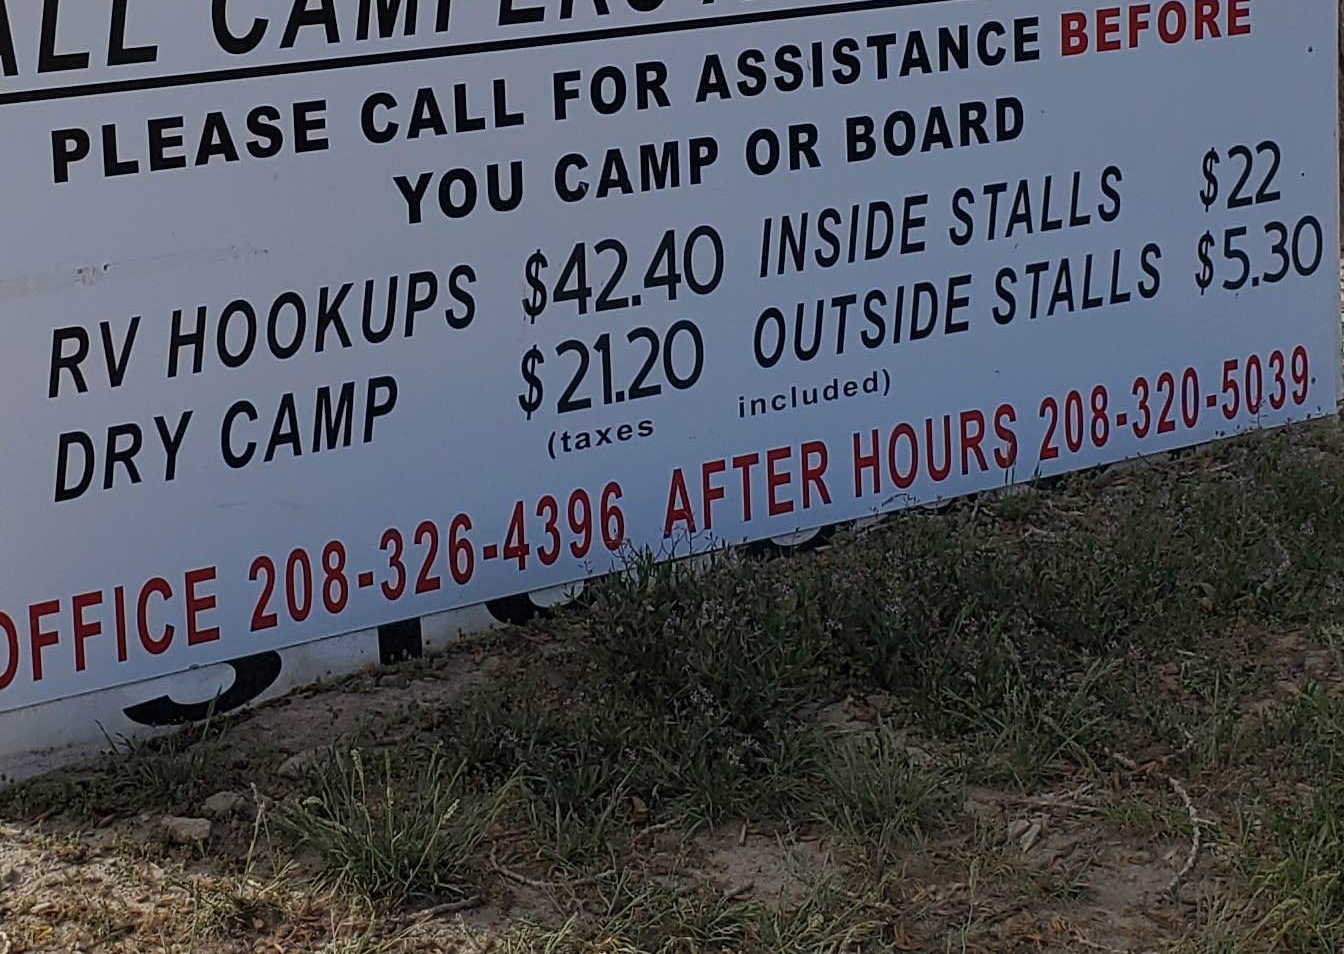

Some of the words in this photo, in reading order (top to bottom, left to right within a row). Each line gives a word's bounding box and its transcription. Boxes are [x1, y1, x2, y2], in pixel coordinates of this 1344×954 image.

[52, 100, 328, 183] PLEASE
[361, 79, 524, 143] CALL
[554, 62, 670, 120] FOR
[696, 17, 1040, 103] ASSISTANCE
[393, 161, 523, 224] YOU
[555, 137, 718, 202] CAMP
[746, 124, 821, 175] OR
[846, 97, 1023, 162] BOARD
[760, 194, 928, 277] INSIDE
[950, 166, 1122, 245] STALLS
[1200, 141, 1280, 212] $22
[49, 317, 141, 398] RV
[168, 265, 476, 377] HOOKUPS
[522, 225, 724, 324] $42.40
[755, 274, 972, 368] OUTSIDE
[992, 243, 1161, 324] STALLS
[1195, 216, 1322, 295] $5.30
[55, 411, 193, 502] DRY
[221, 376, 397, 468] CAMP
[519, 320, 703, 420] $21.20
[548, 420, 653, 459] (taxes
[740, 369, 890, 417] included)
[664, 441, 832, 540] AFTER
[853, 403, 1017, 498] HOURS
[1039, 345, 1308, 460] 208-320-5039
[249, 481, 624, 633] 208-326-4396
